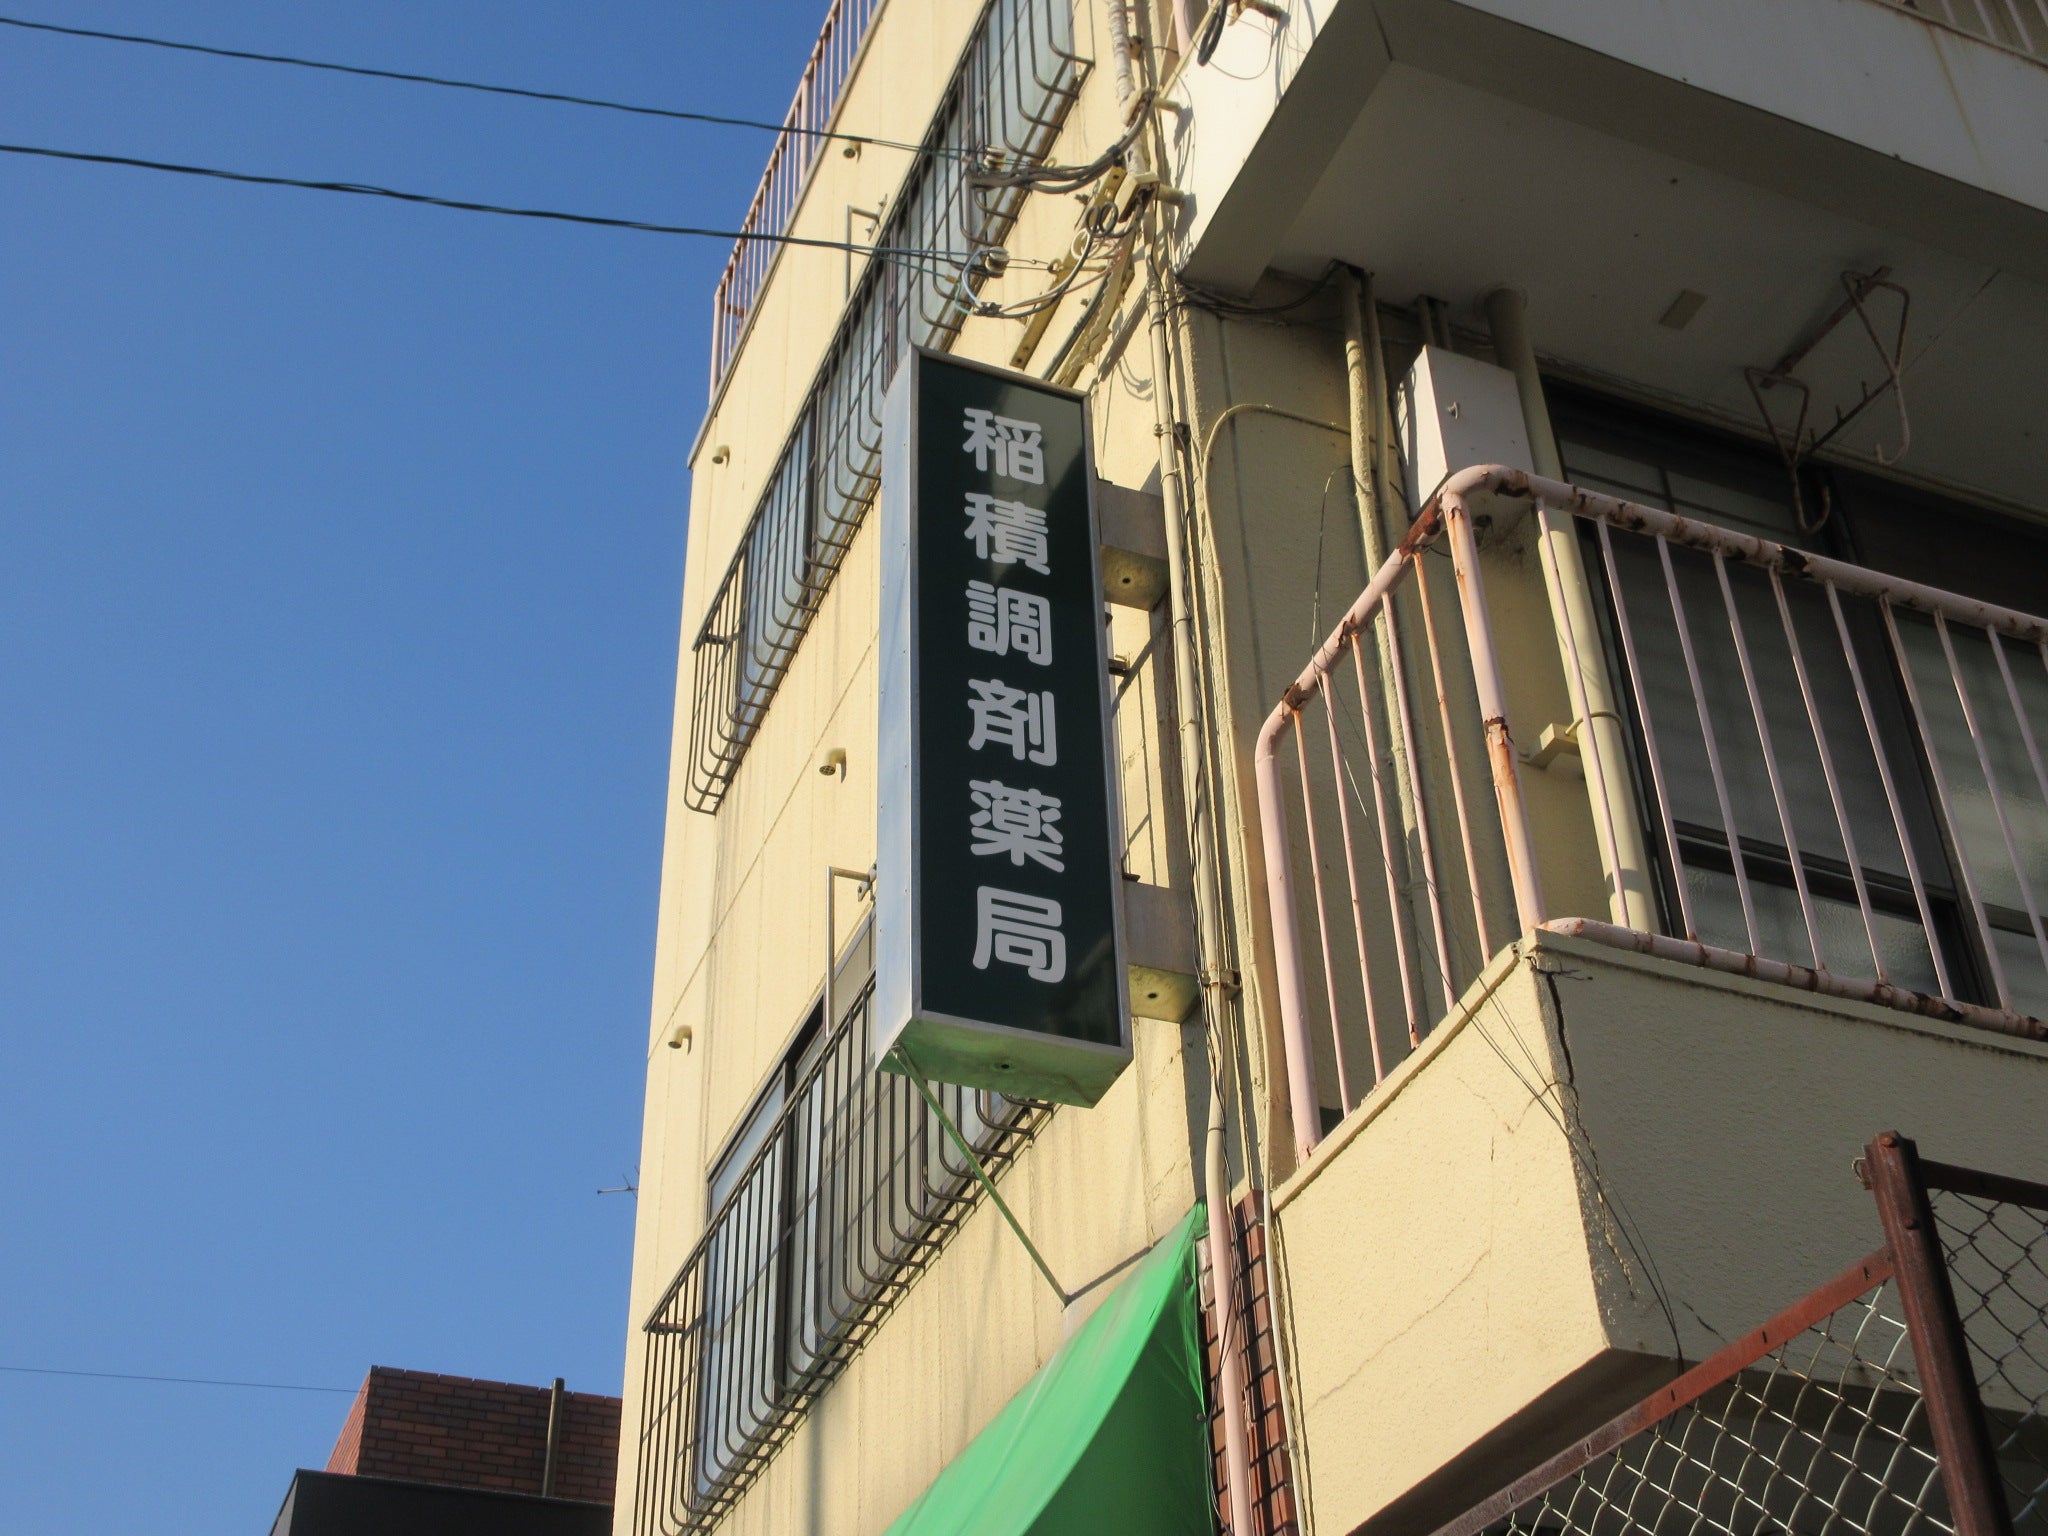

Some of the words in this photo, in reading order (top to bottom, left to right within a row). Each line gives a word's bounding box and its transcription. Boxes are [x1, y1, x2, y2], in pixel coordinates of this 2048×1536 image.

[962, 406, 1067, 984] 稲積調剤薬局
